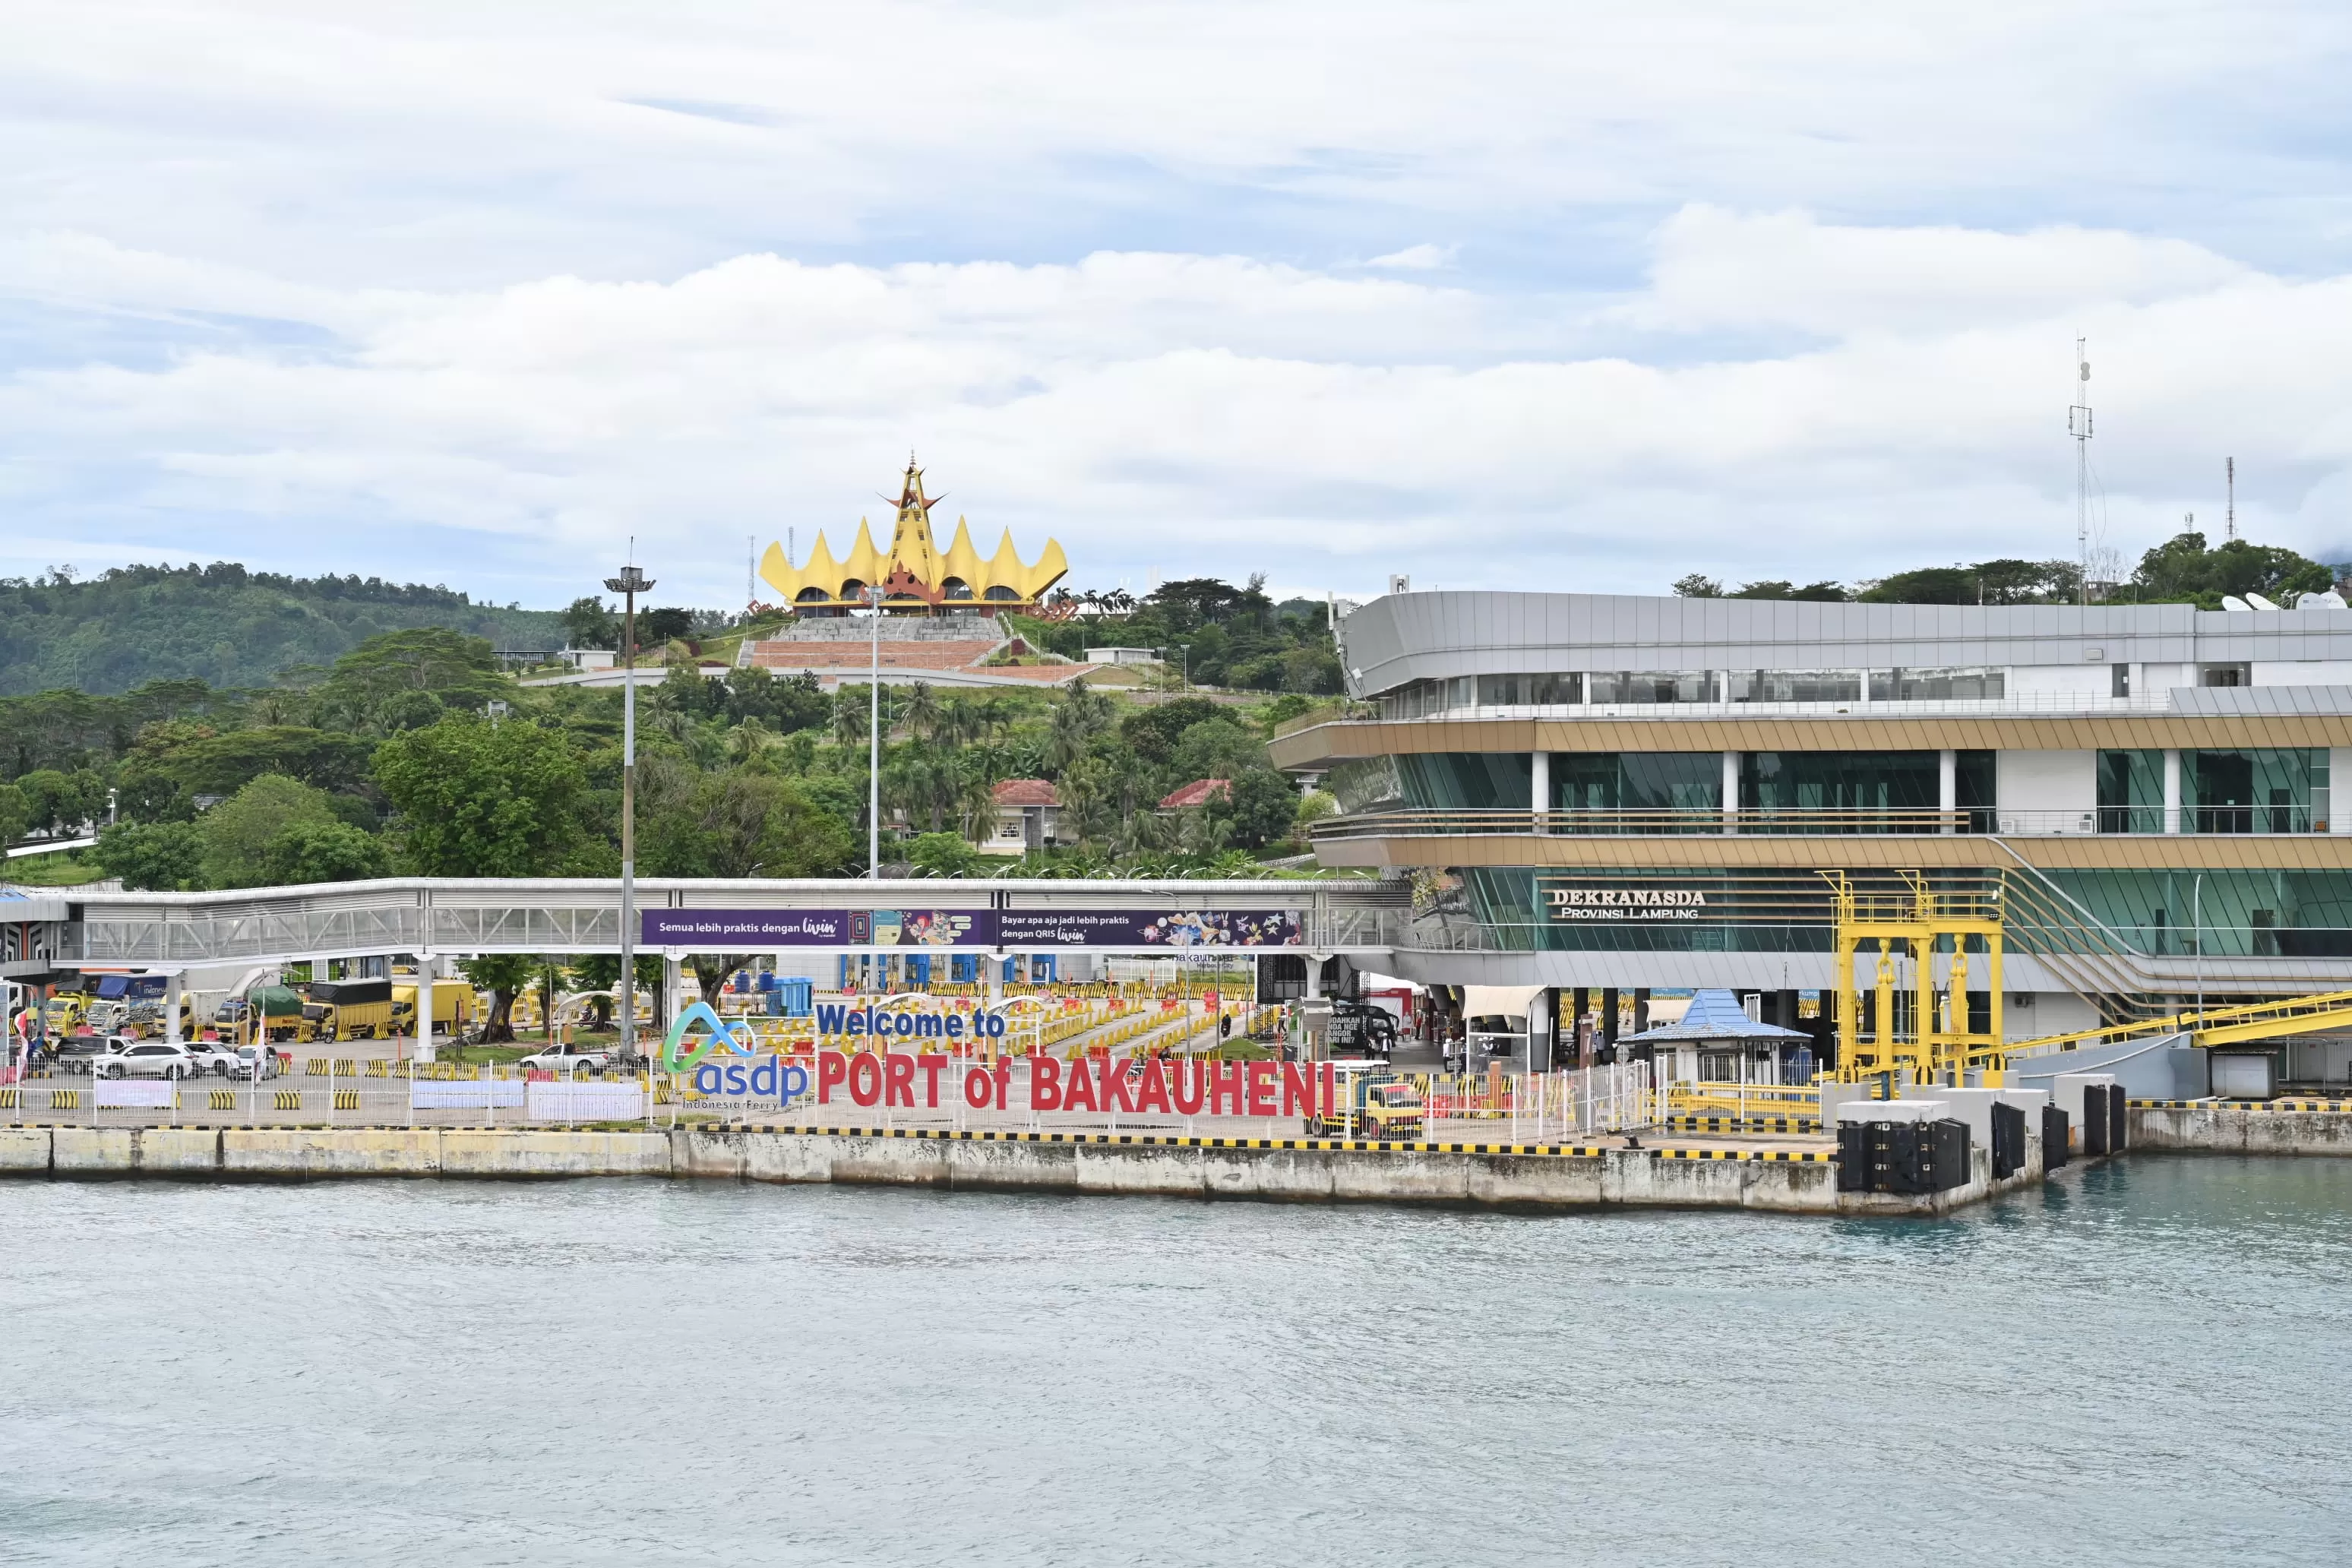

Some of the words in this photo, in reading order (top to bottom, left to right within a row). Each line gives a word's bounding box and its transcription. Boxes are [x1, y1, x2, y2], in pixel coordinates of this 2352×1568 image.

[1553, 890, 1706, 906] DEKRANASDA
[1561, 907, 1623, 918] PROVINSI
[1630, 907, 1699, 919] LAMPUNG
[1001, 916, 1026, 925] Bayar
[1045, 916, 1057, 925] aja
[1058, 916, 1075, 925] jadi
[1076, 916, 1098, 925] lebih
[1100, 916, 1129, 925] praktis
[659, 922, 694, 931] Semua
[696, 922, 721, 931] lebih
[724, 922, 759, 934] praktis
[762, 922, 799, 934] dengan
[1001, 930, 1034, 939] dengan
[1035, 930, 1055, 938] QRIS
[816, 1004, 965, 1038] Welcome
[972, 1007, 1006, 1038] to
[696, 1054, 809, 1108] asdp
[818, 1051, 949, 1108] PORT
[964, 1054, 1014, 1111] of
[1030, 1056, 1337, 1118] BAKAUHENI
[682, 1099, 741, 1110] Indonesia
[746, 1099, 778, 1111] Ferry
